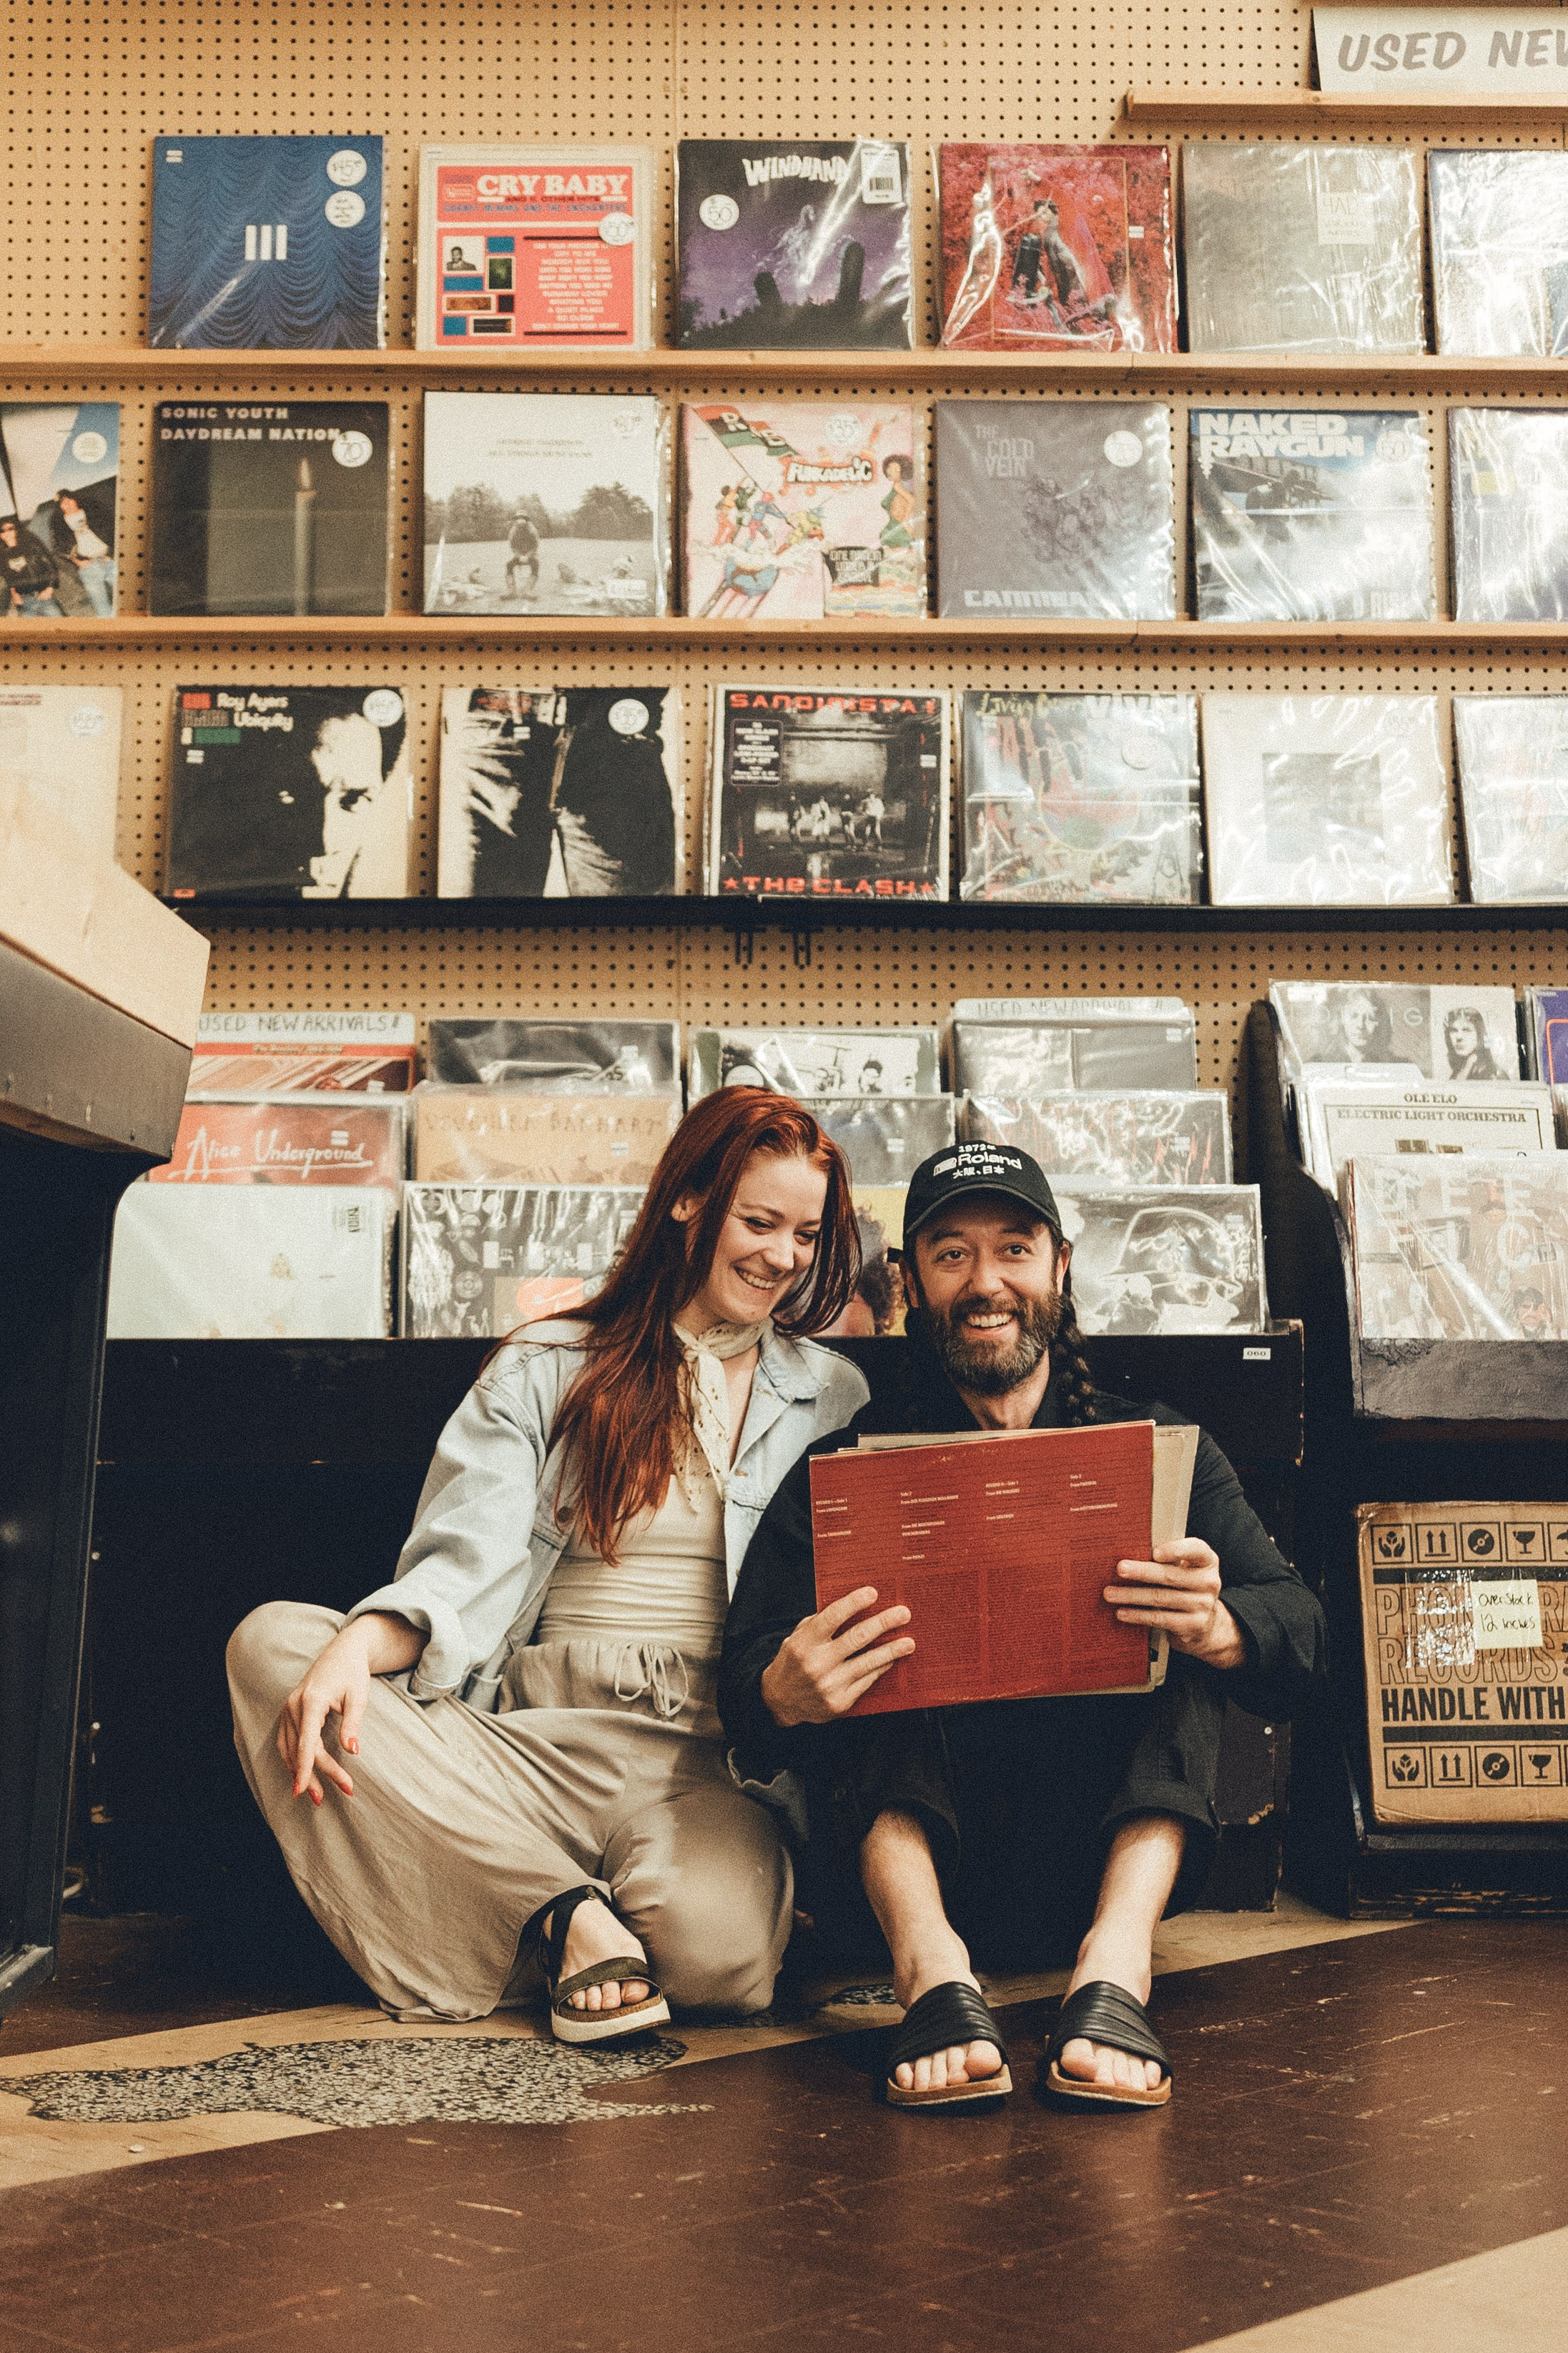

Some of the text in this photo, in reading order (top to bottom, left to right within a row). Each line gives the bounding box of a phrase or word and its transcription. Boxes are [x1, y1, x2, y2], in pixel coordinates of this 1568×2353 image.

[1338, 31, 1466, 72] USED
[476, 175, 541, 196] CRY
[543, 175, 628, 196] BABY
[161, 408, 288, 419] SONIC YOUTH
[161, 428, 340, 441] DAYDREAM NATION
[1198, 413, 1348, 436] NAKED
[987, 437, 1035, 459] COLD
[1199, 436, 1364, 458] RAYGUN
[985, 458, 1026, 478] VEIN
[217, 692, 289, 712] Roy Ayers
[233, 712, 295, 732] Ubiquity
[742, 876, 917, 894] THE CLASH
[199, 1014, 246, 1032] USED
[258, 1013, 302, 1032] NEW
[1432, 1094, 1457, 1104] ELO
[1337, 1109, 1527, 1123] ELECTRIC LIGHT ORCHESTRA
[180, 1126, 367, 1180] Alice Underground
[958, 1151, 1022, 1170] Roland
[1480, 1613, 1498, 1632] 12
[1377, 1634, 1559, 1684] RECORDS
[1381, 1686, 1566, 1722] HANDLE WITH
